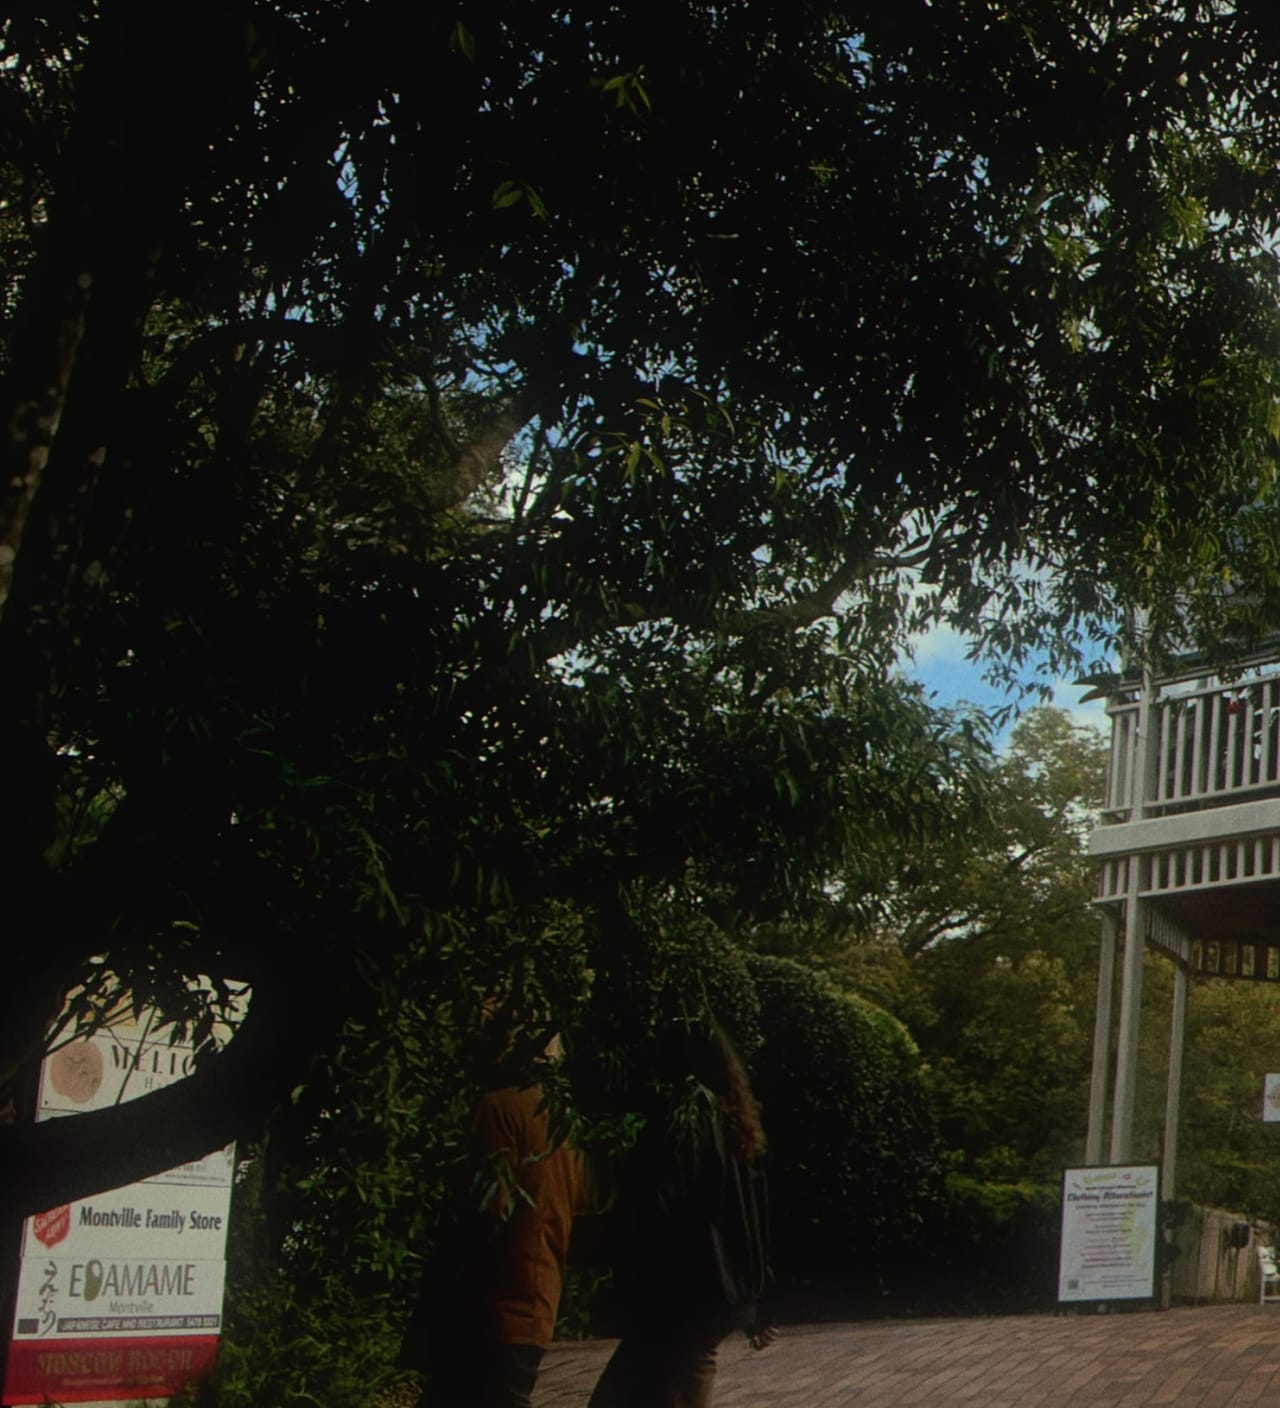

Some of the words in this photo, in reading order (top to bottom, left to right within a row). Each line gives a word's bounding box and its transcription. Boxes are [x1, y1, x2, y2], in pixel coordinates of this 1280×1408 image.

[79, 1206, 142, 1228] Montville
[145, 1209, 186, 1234] Family
[189, 1210, 222, 1231] Store
[109, 1299, 154, 1313] Montville
[62, 1320, 101, 1330] JAPANESE
[101, 1319, 121, 1330] CAFE
